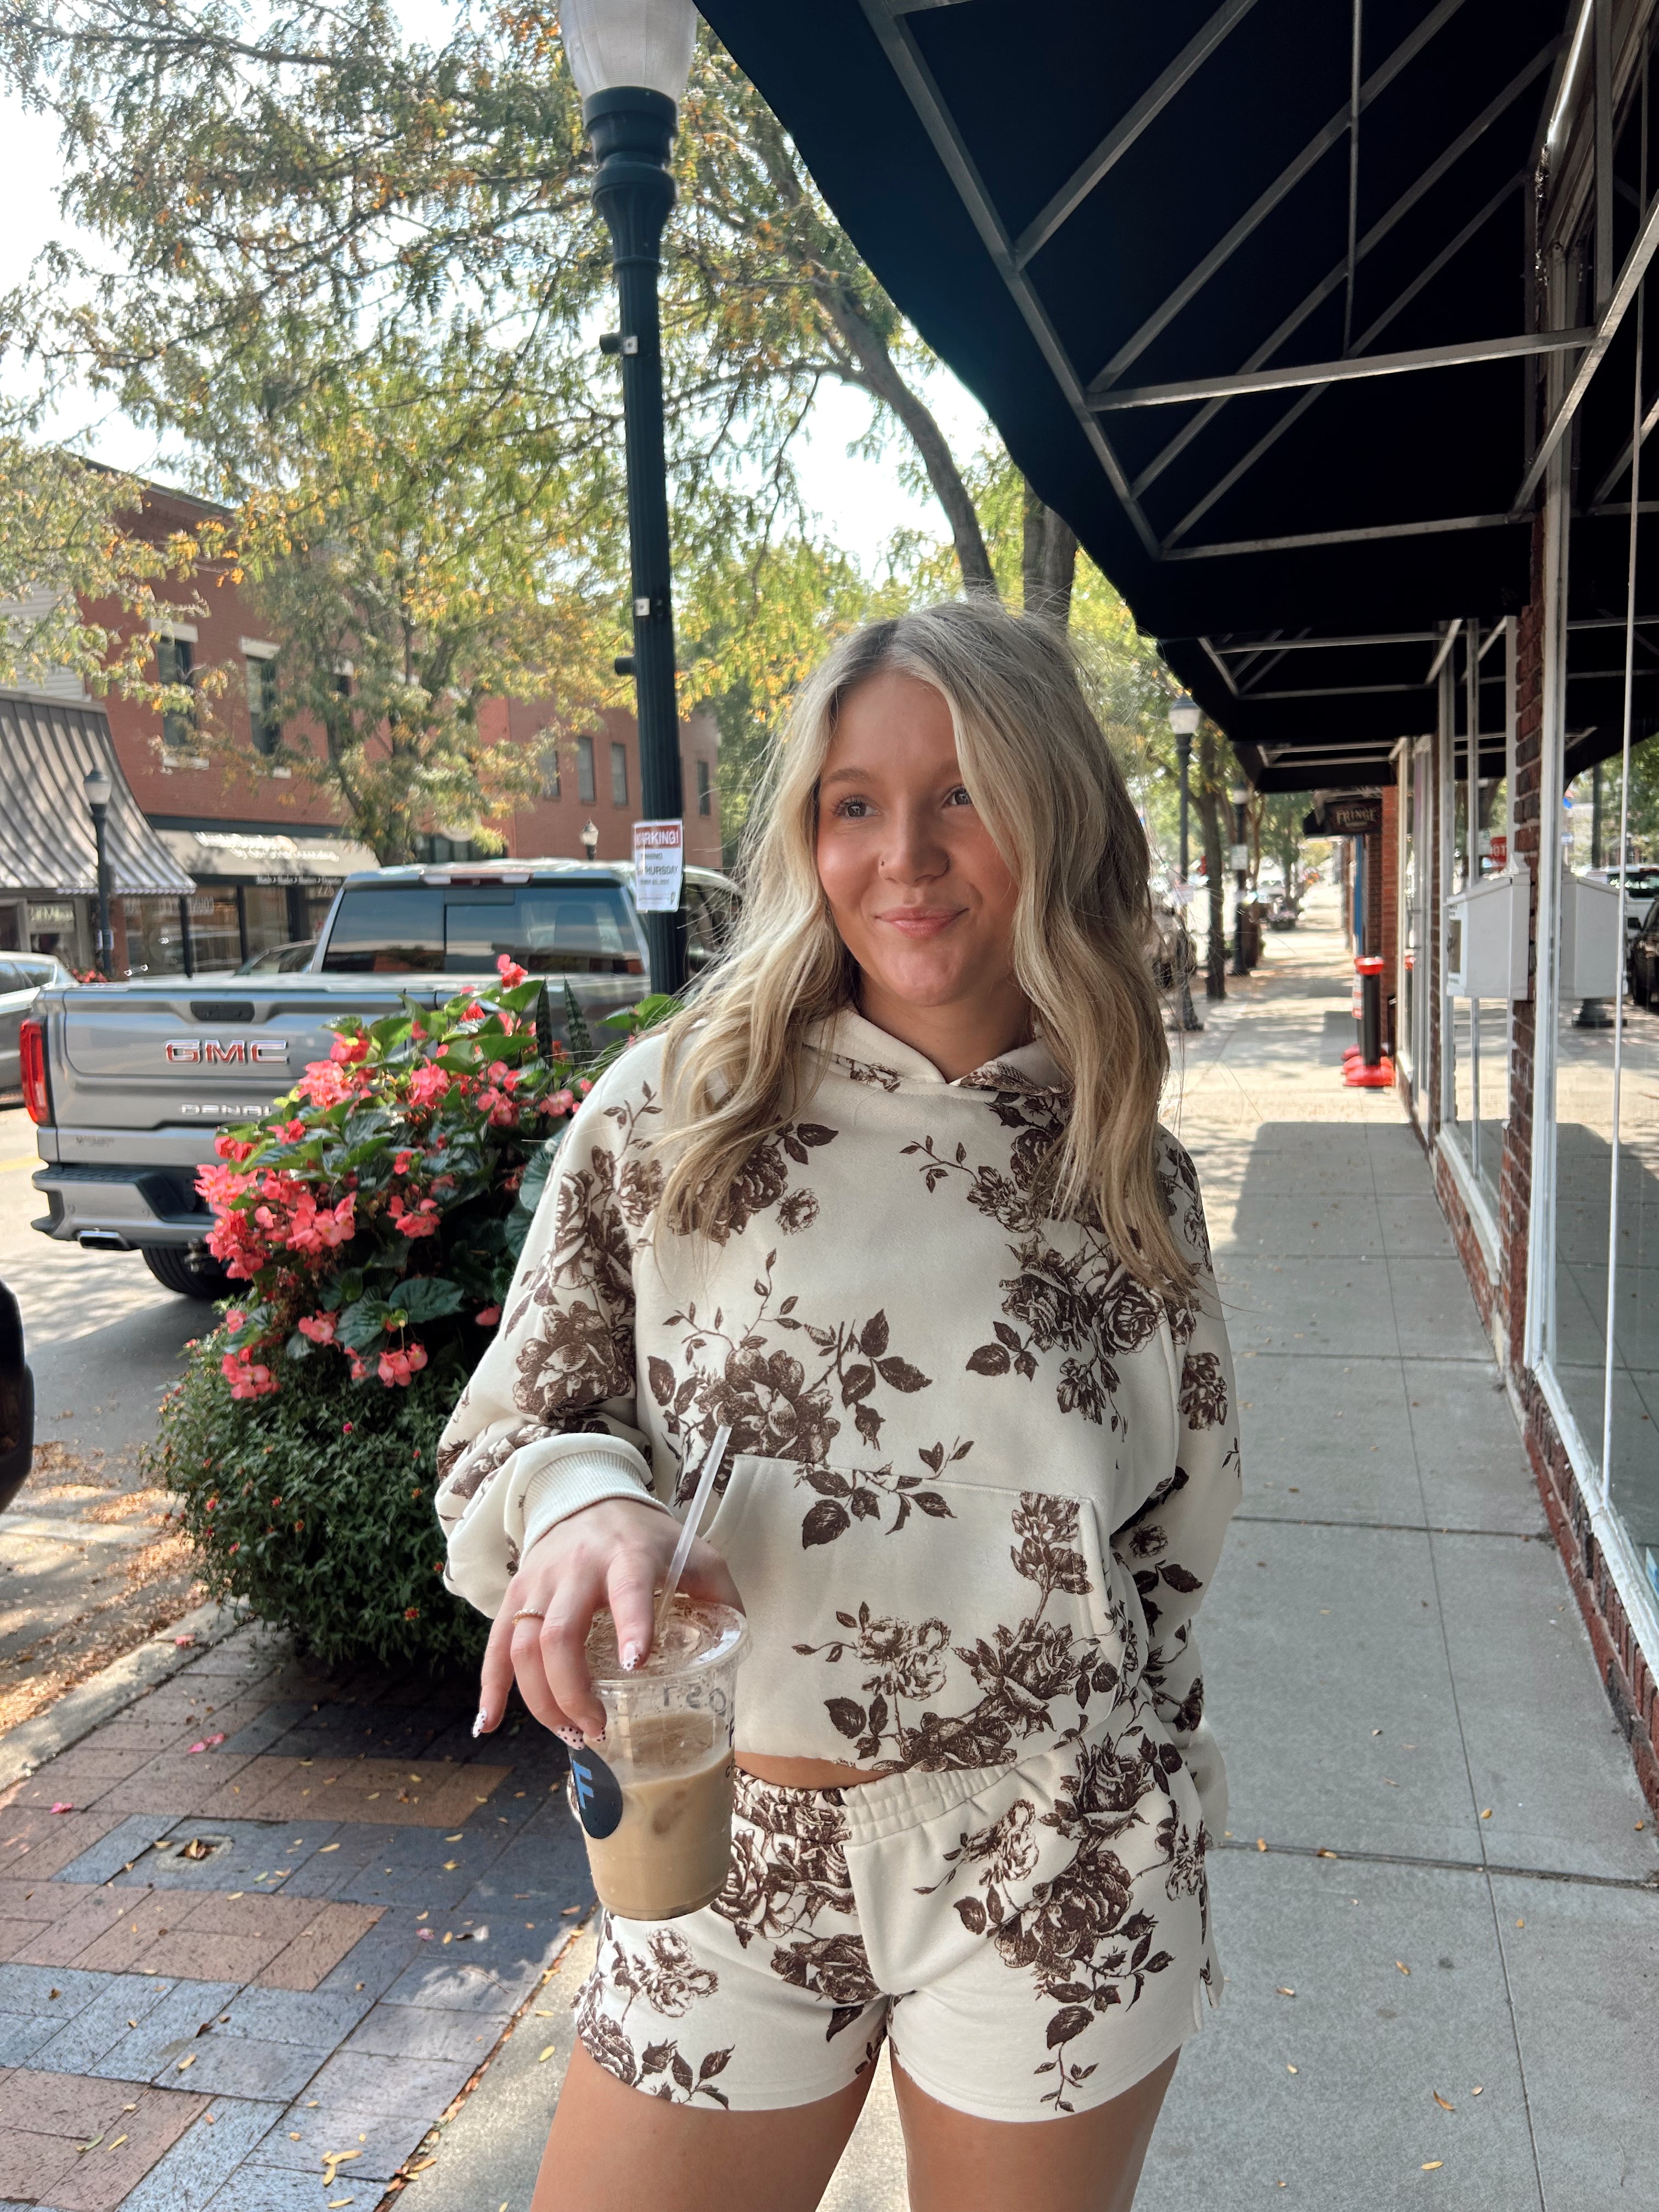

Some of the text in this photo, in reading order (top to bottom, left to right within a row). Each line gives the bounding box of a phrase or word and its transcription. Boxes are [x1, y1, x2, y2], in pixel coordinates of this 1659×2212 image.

[1336, 808, 1377, 826] FRINGE
[165, 1039, 287, 1065] GMC
[181, 1104, 274, 1117] DENAL
